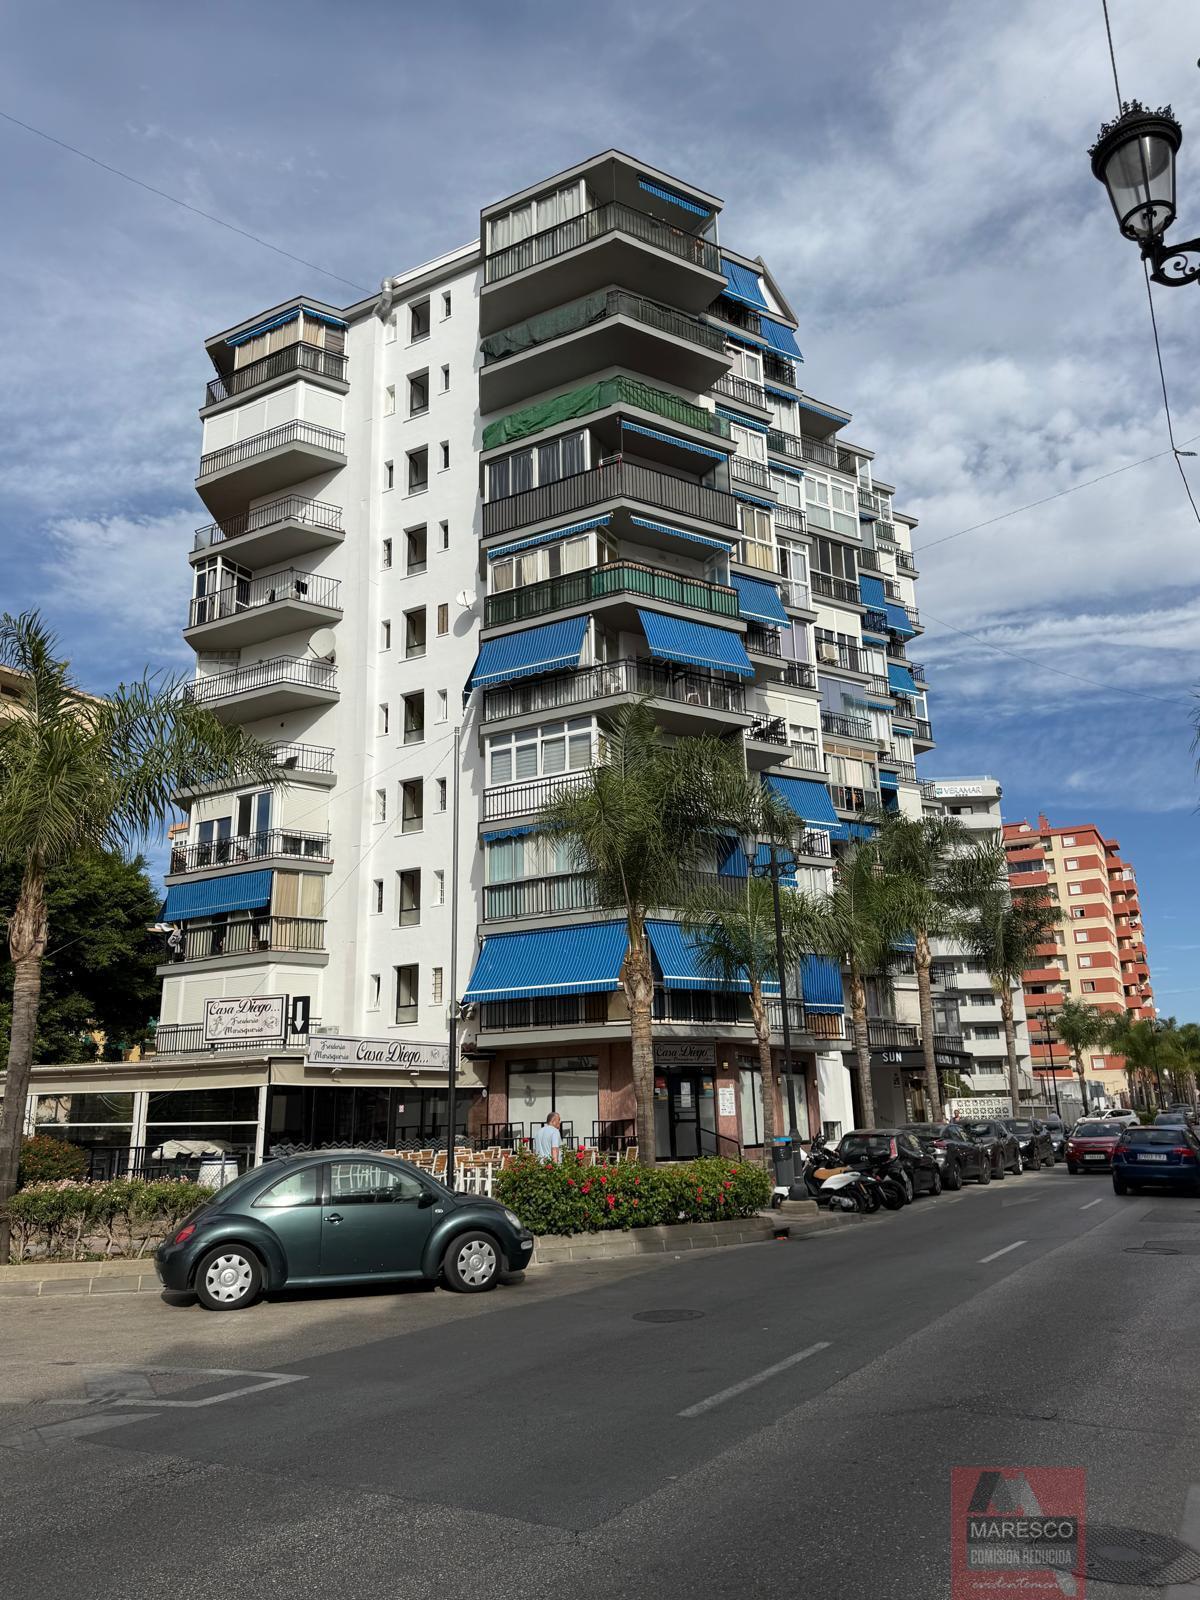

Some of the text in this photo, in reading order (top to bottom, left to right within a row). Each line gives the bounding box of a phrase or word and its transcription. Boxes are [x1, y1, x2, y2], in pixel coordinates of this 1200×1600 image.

[943, 786, 982, 795] VERAMAR
[209, 1001, 234, 1015] Casa
[356, 1040, 386, 1061] Casa
[656, 1043, 677, 1057] Casa
[882, 1051, 903, 1063] SUN
